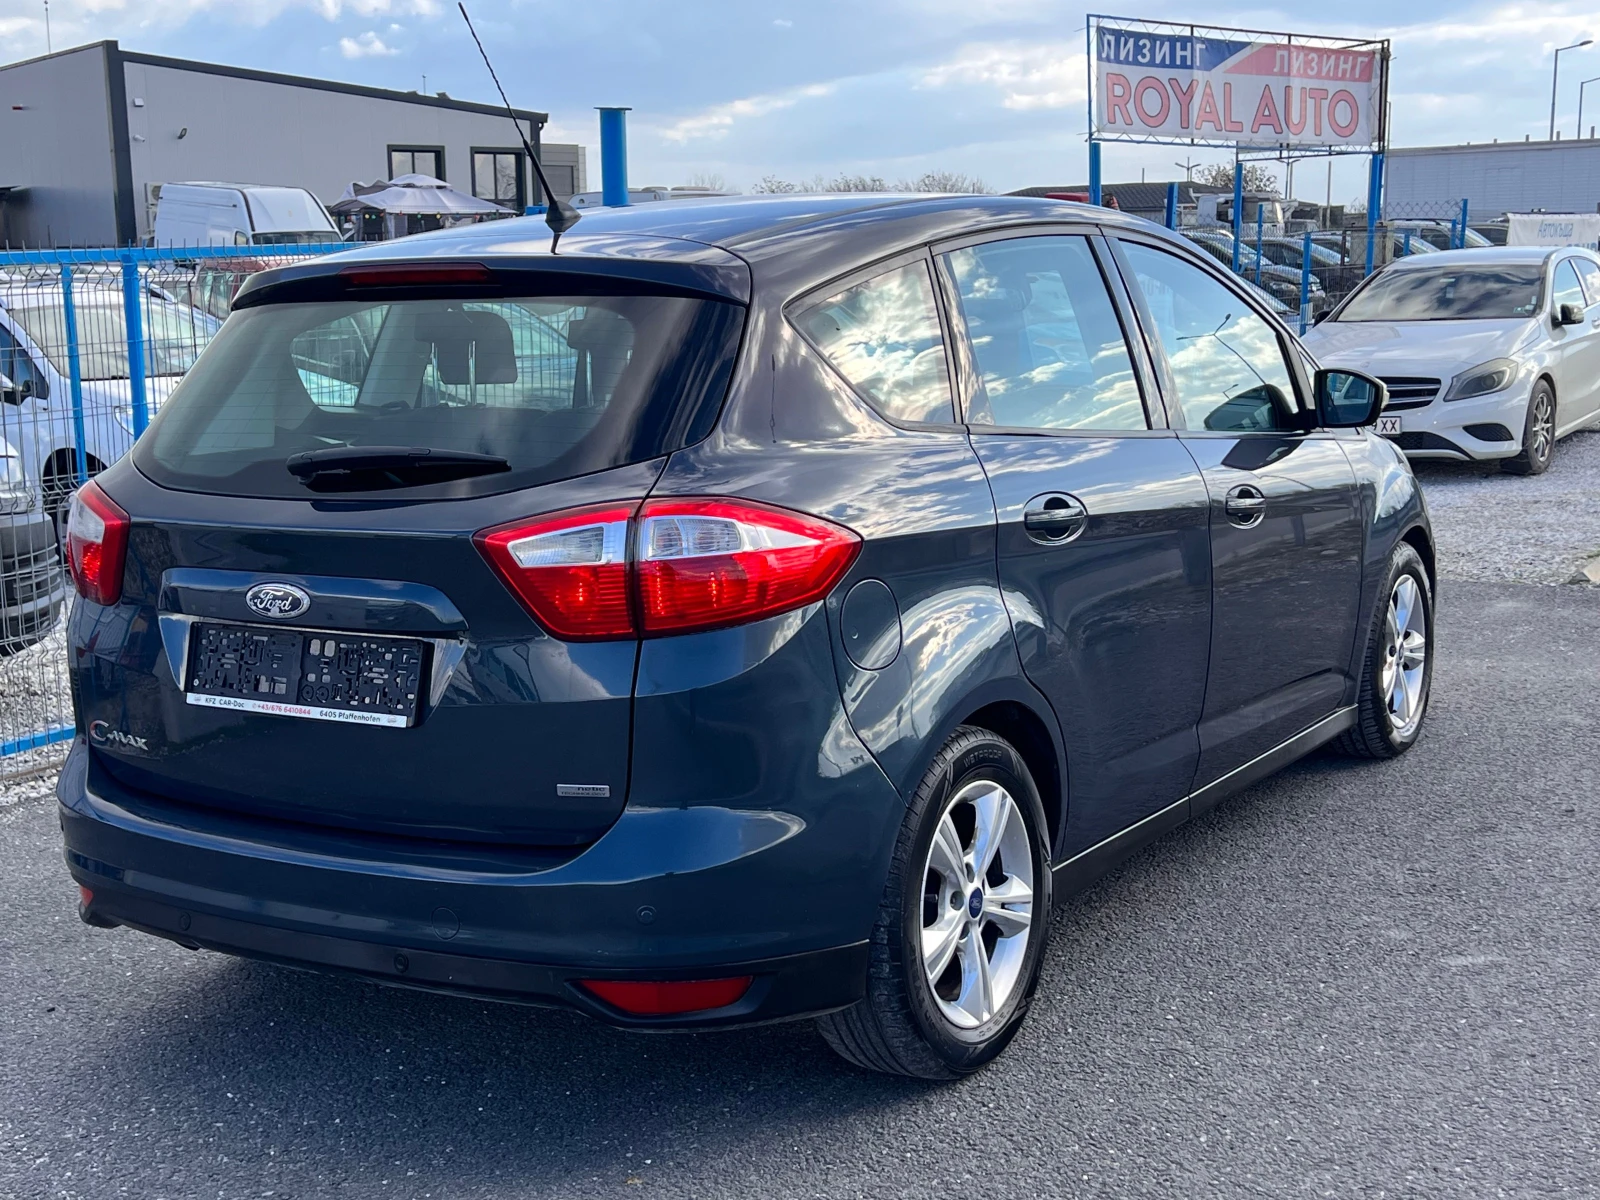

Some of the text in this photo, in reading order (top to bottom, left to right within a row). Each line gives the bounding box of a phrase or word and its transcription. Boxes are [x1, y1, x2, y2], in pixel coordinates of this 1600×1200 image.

[1101, 34, 1205, 66] ЛИЗИНГ
[1273, 50, 1368, 79] ЛИЗИНГ
[1106, 72, 1359, 138] ROYAL AUTO
[254, 589, 292, 610] Ford
[205, 697, 217, 705] KFZ
[218, 699, 245, 708] CAR-Doc
[319, 710, 337, 719] 6405
[338, 712, 381, 723] Pfaffenhofen
